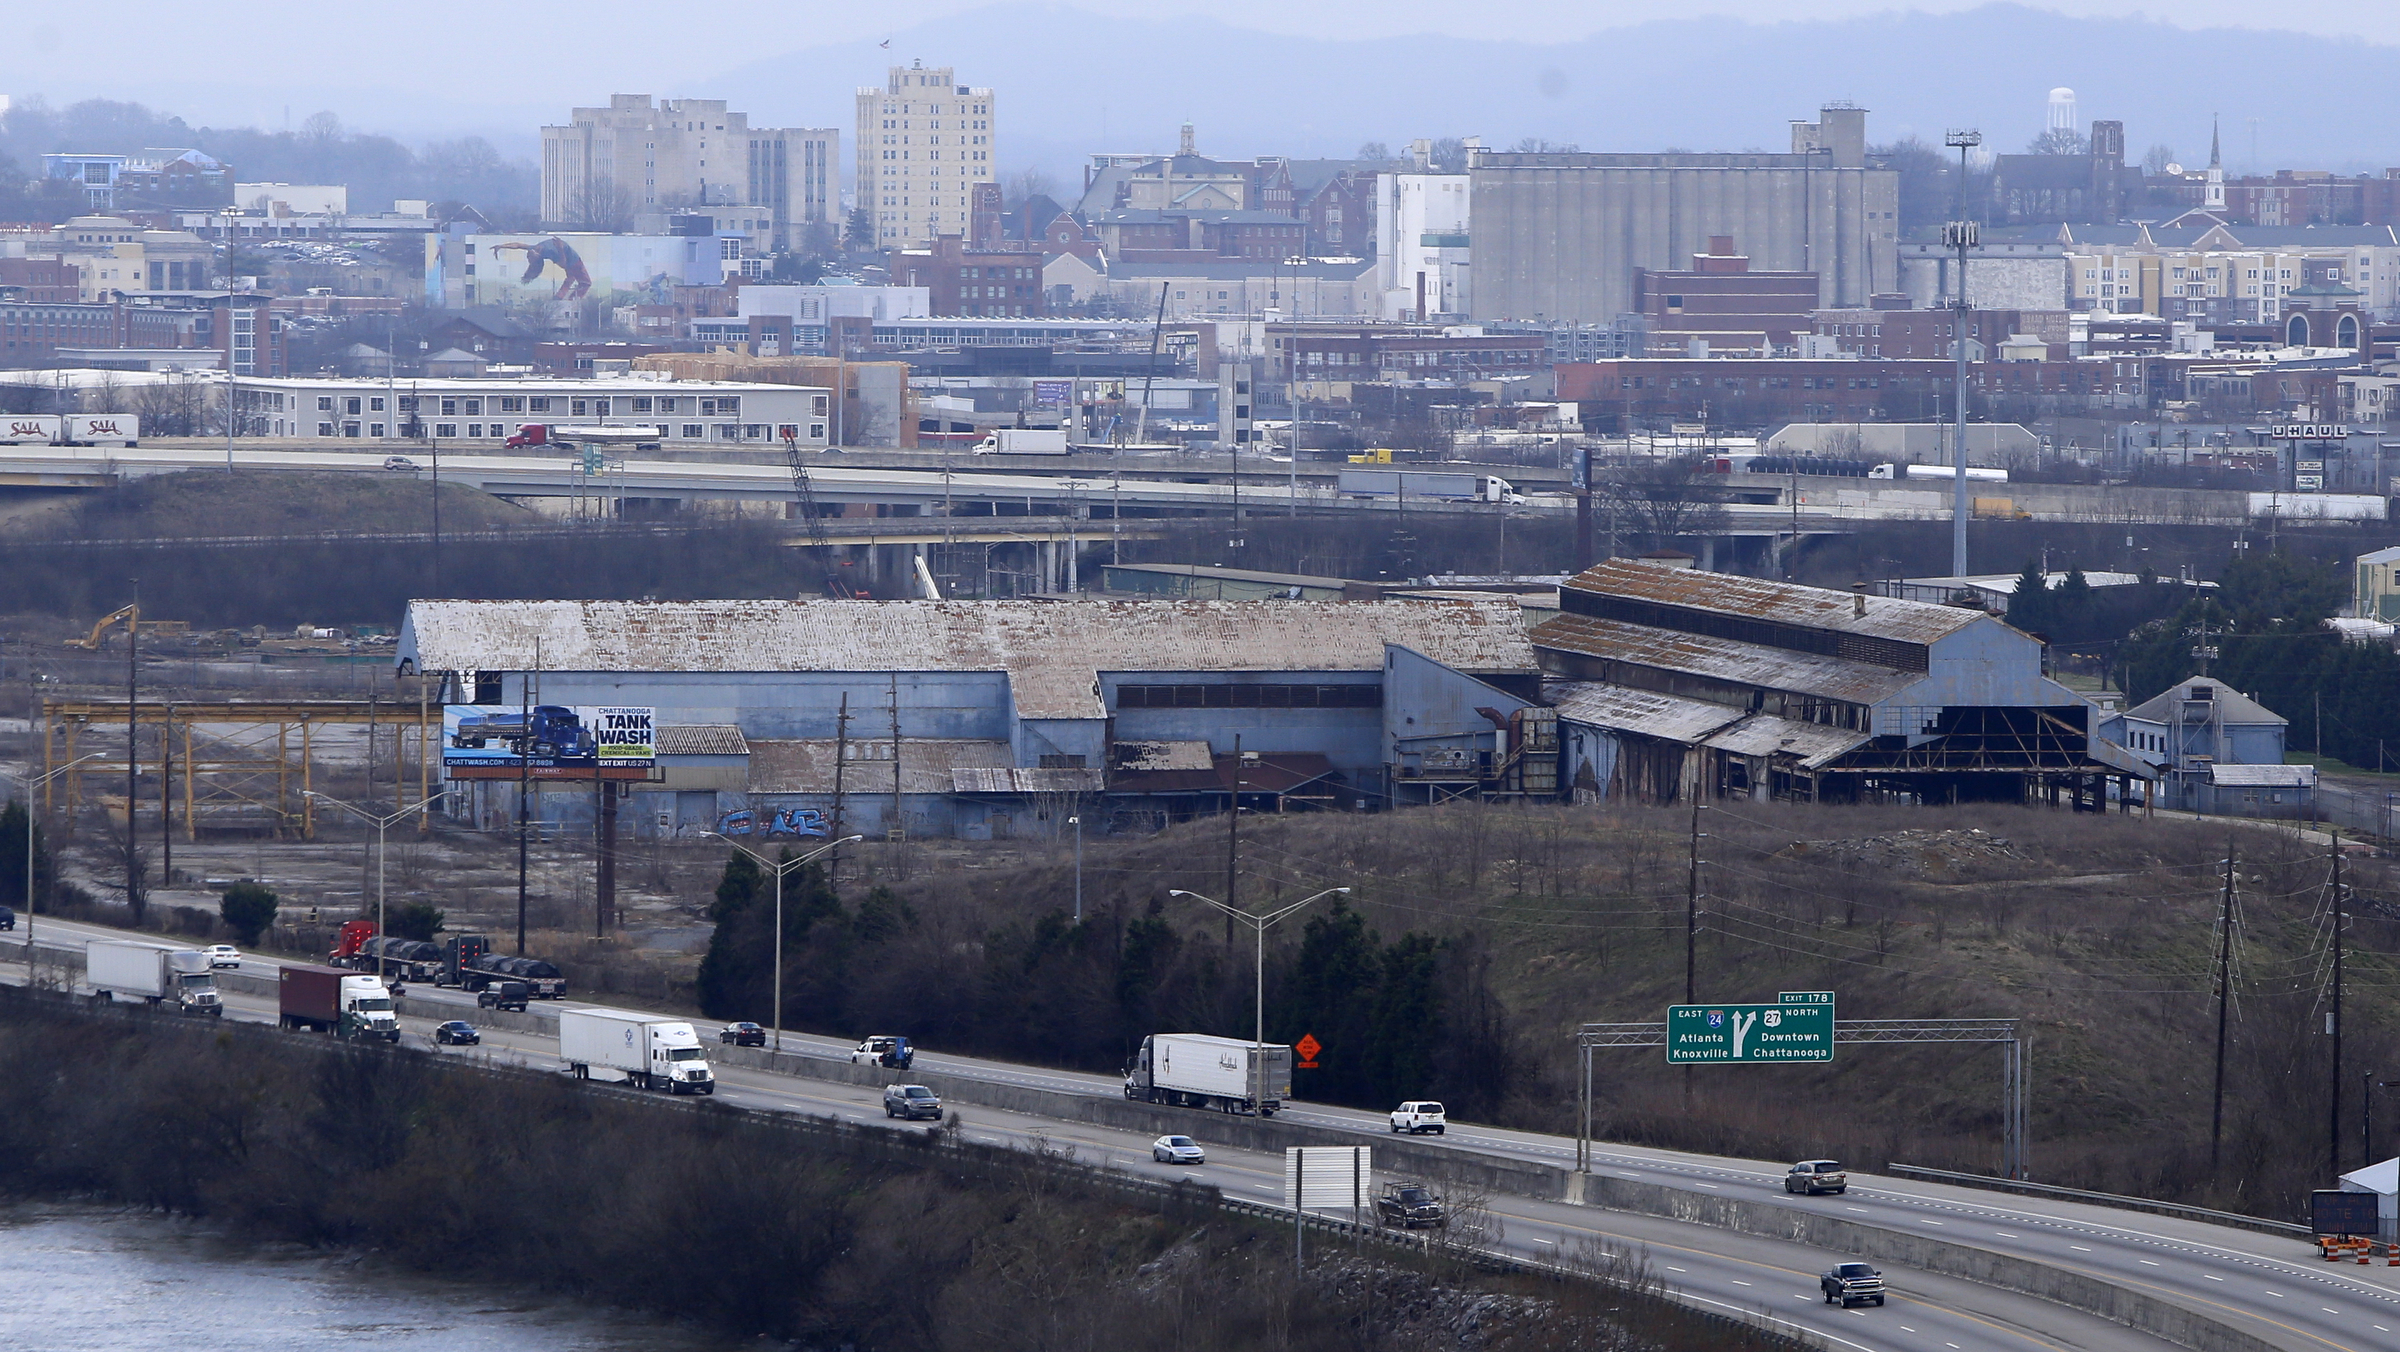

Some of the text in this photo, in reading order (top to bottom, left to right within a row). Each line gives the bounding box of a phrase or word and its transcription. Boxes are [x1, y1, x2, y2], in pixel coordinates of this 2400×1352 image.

[10, 422, 47, 437] SAIA
[87, 420, 123, 435] SAIA
[605, 715, 651, 729] TANK
[599, 730, 651, 744] WASH
[1808, 994, 1828, 1002] 178
[1678, 1010, 1722, 1025] EAST 24
[1765, 1013, 1779, 1024] 27
[1679, 1034, 1724, 1043] Atlanta
[1761, 1033, 1819, 1042] Downtown
[1673, 1049, 1728, 1059] Knoxville
[1753, 1048, 1827, 1059] Chattanooga
